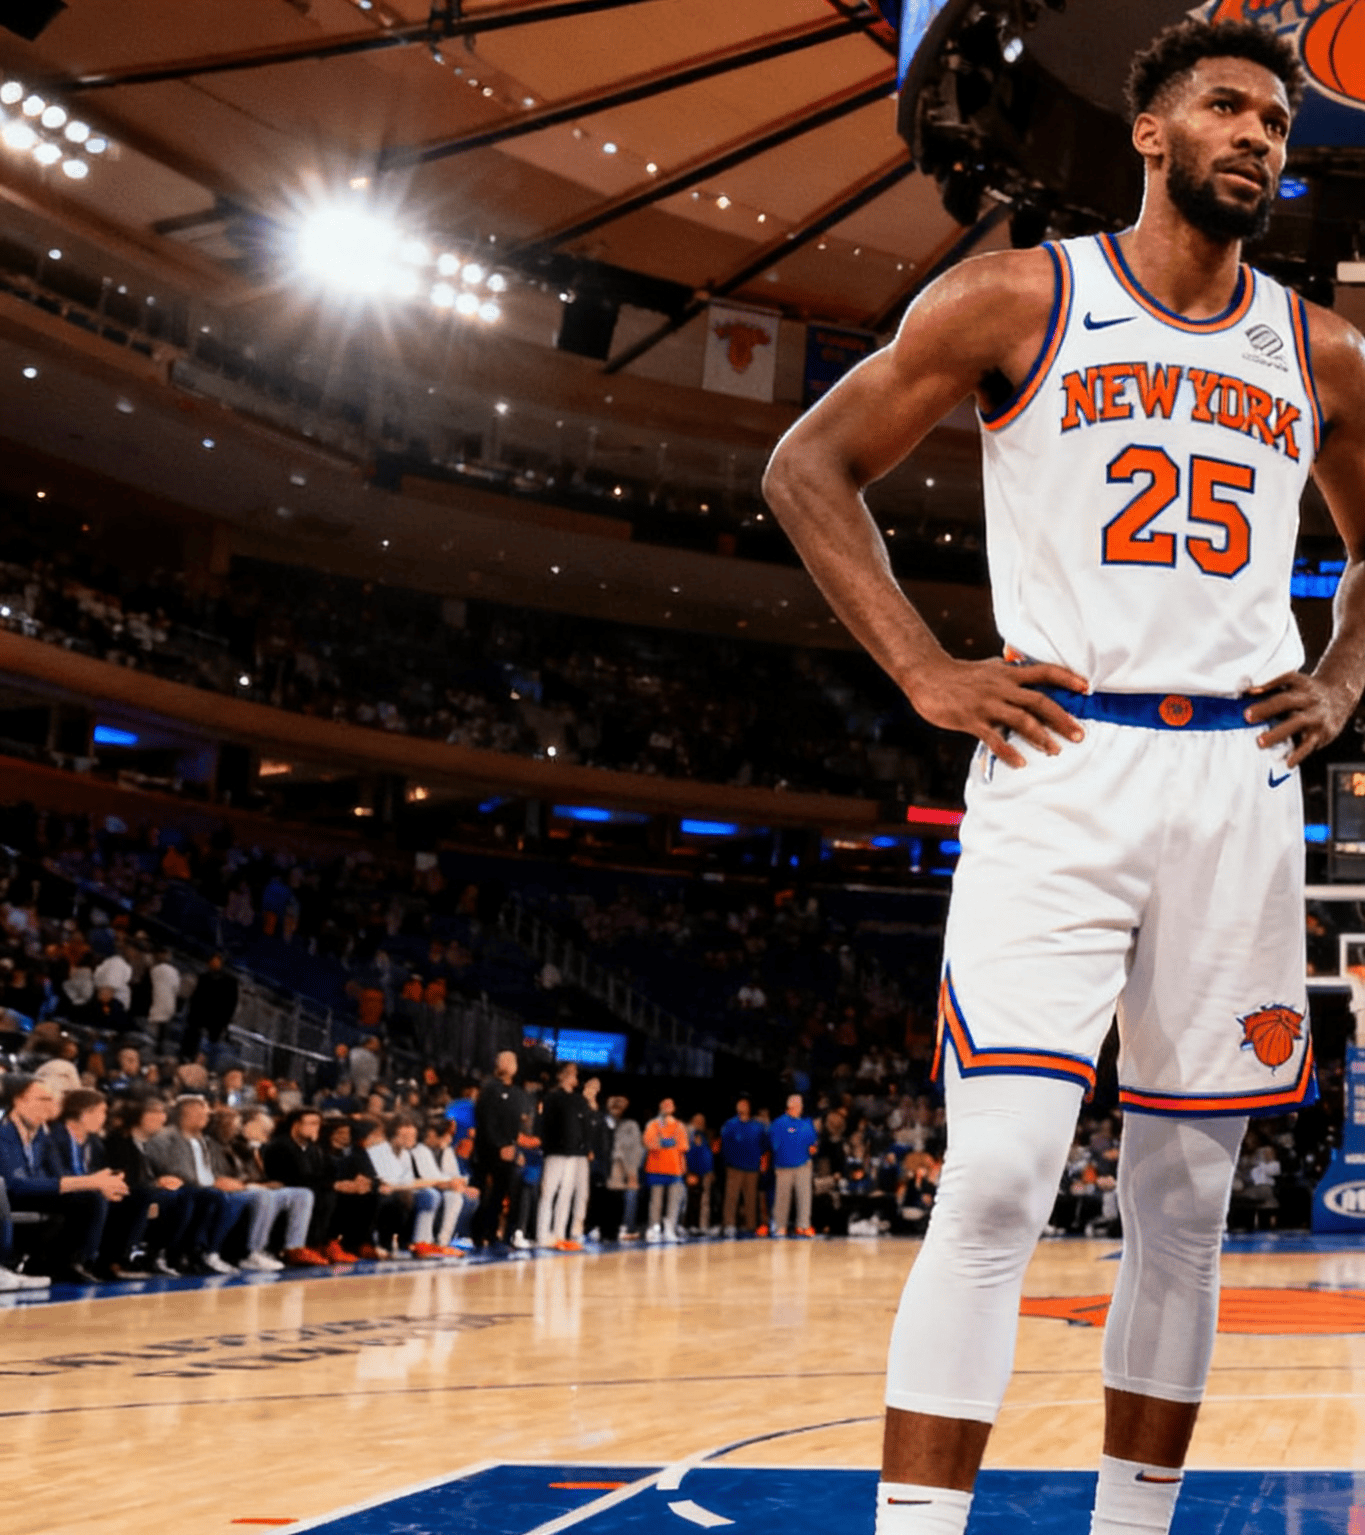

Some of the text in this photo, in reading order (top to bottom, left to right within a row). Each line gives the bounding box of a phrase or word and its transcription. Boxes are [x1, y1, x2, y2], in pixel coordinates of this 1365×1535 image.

[1060, 361, 1301, 464] NEW YORK
[1101, 442, 1257, 580] 25
